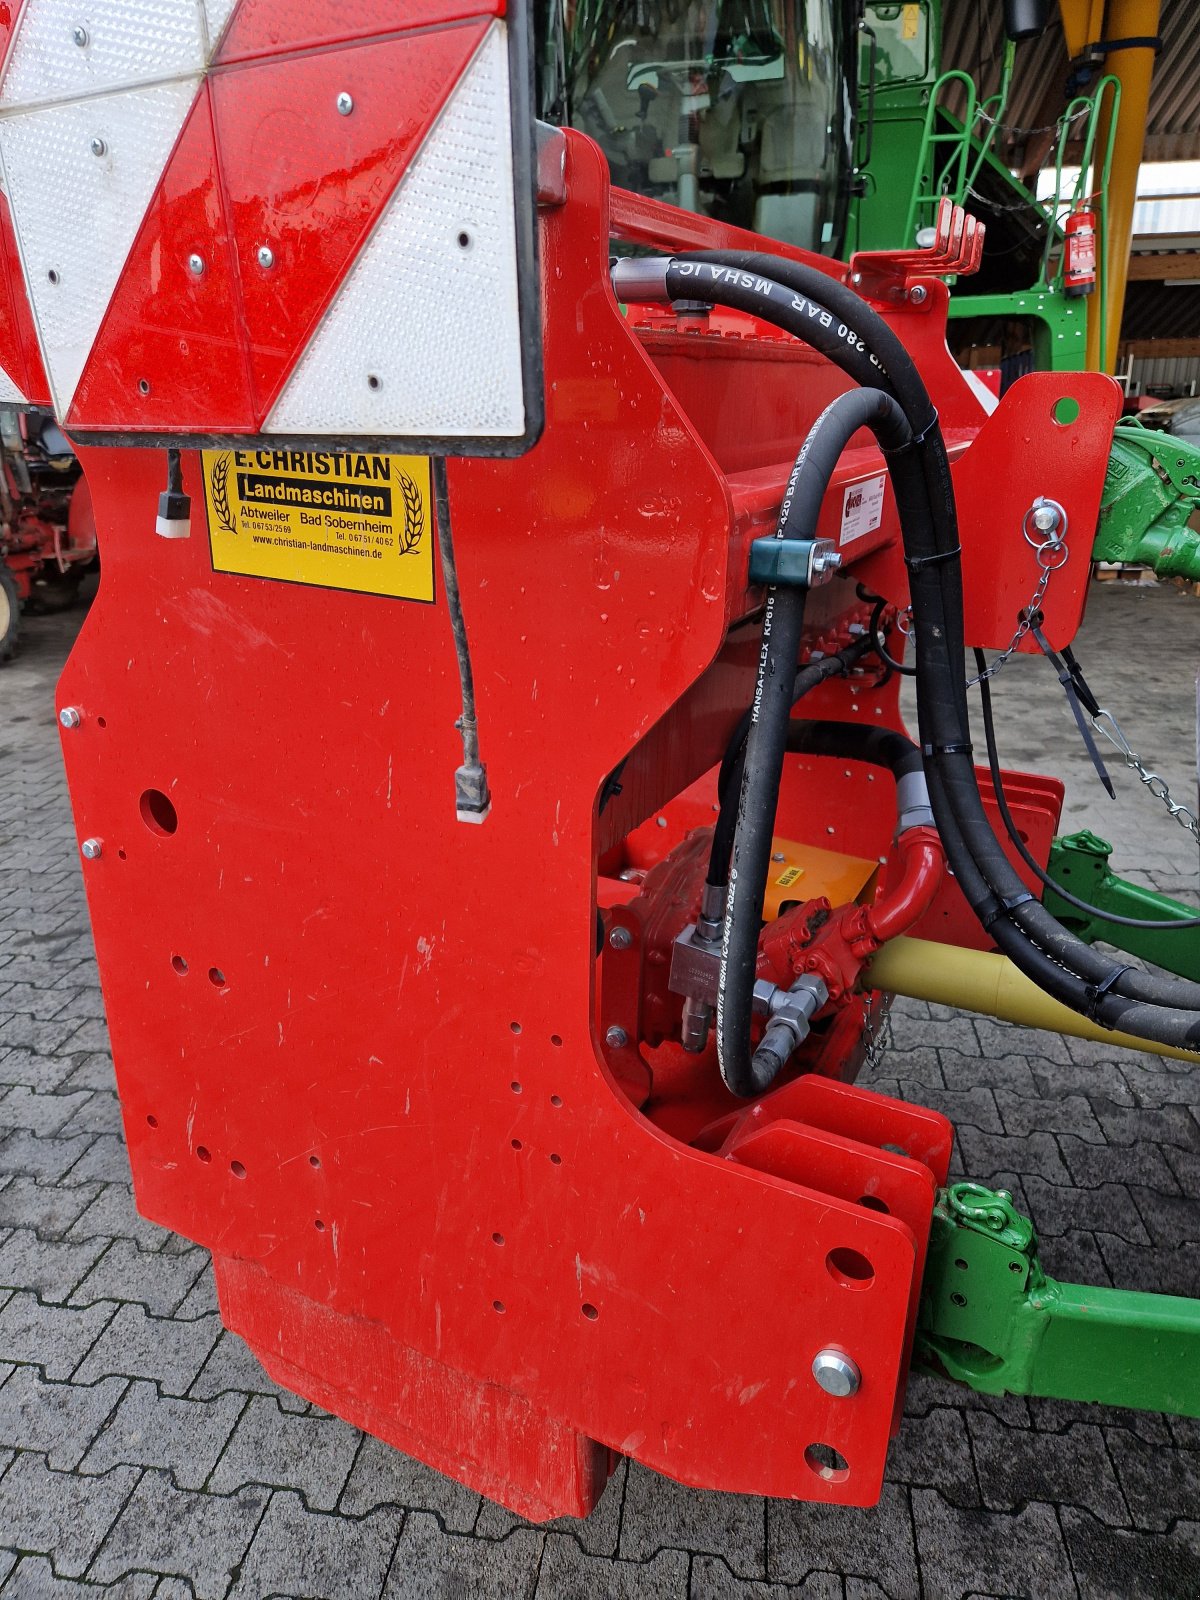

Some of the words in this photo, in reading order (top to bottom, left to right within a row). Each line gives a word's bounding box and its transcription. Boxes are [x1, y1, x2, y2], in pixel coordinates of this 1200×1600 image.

[666, 260, 702, 277] IC-
[709, 265, 773, 296] MSHA
[791, 294, 833, 328] BAR
[837, 323, 865, 352] 280
[244, 478, 384, 511] Landmaschinen
[780, 500, 791, 525] 420
[786, 464, 801, 496] BAR
[798, 443, 810, 465] ISO
[240, 505, 291, 522] Abtweiler
[300, 511, 322, 526] Bad
[324, 514, 393, 534] Sobernheim
[252, 535, 383, 559] www.christian-landmaschinen.de
[335, 531, 347, 541] Tel.
[751, 643, 769, 723] HANSA-FLEX
[763, 597, 775, 636] KP616
[719, 960, 728, 991] MSHA
[726, 882, 736, 912] 2Q22
